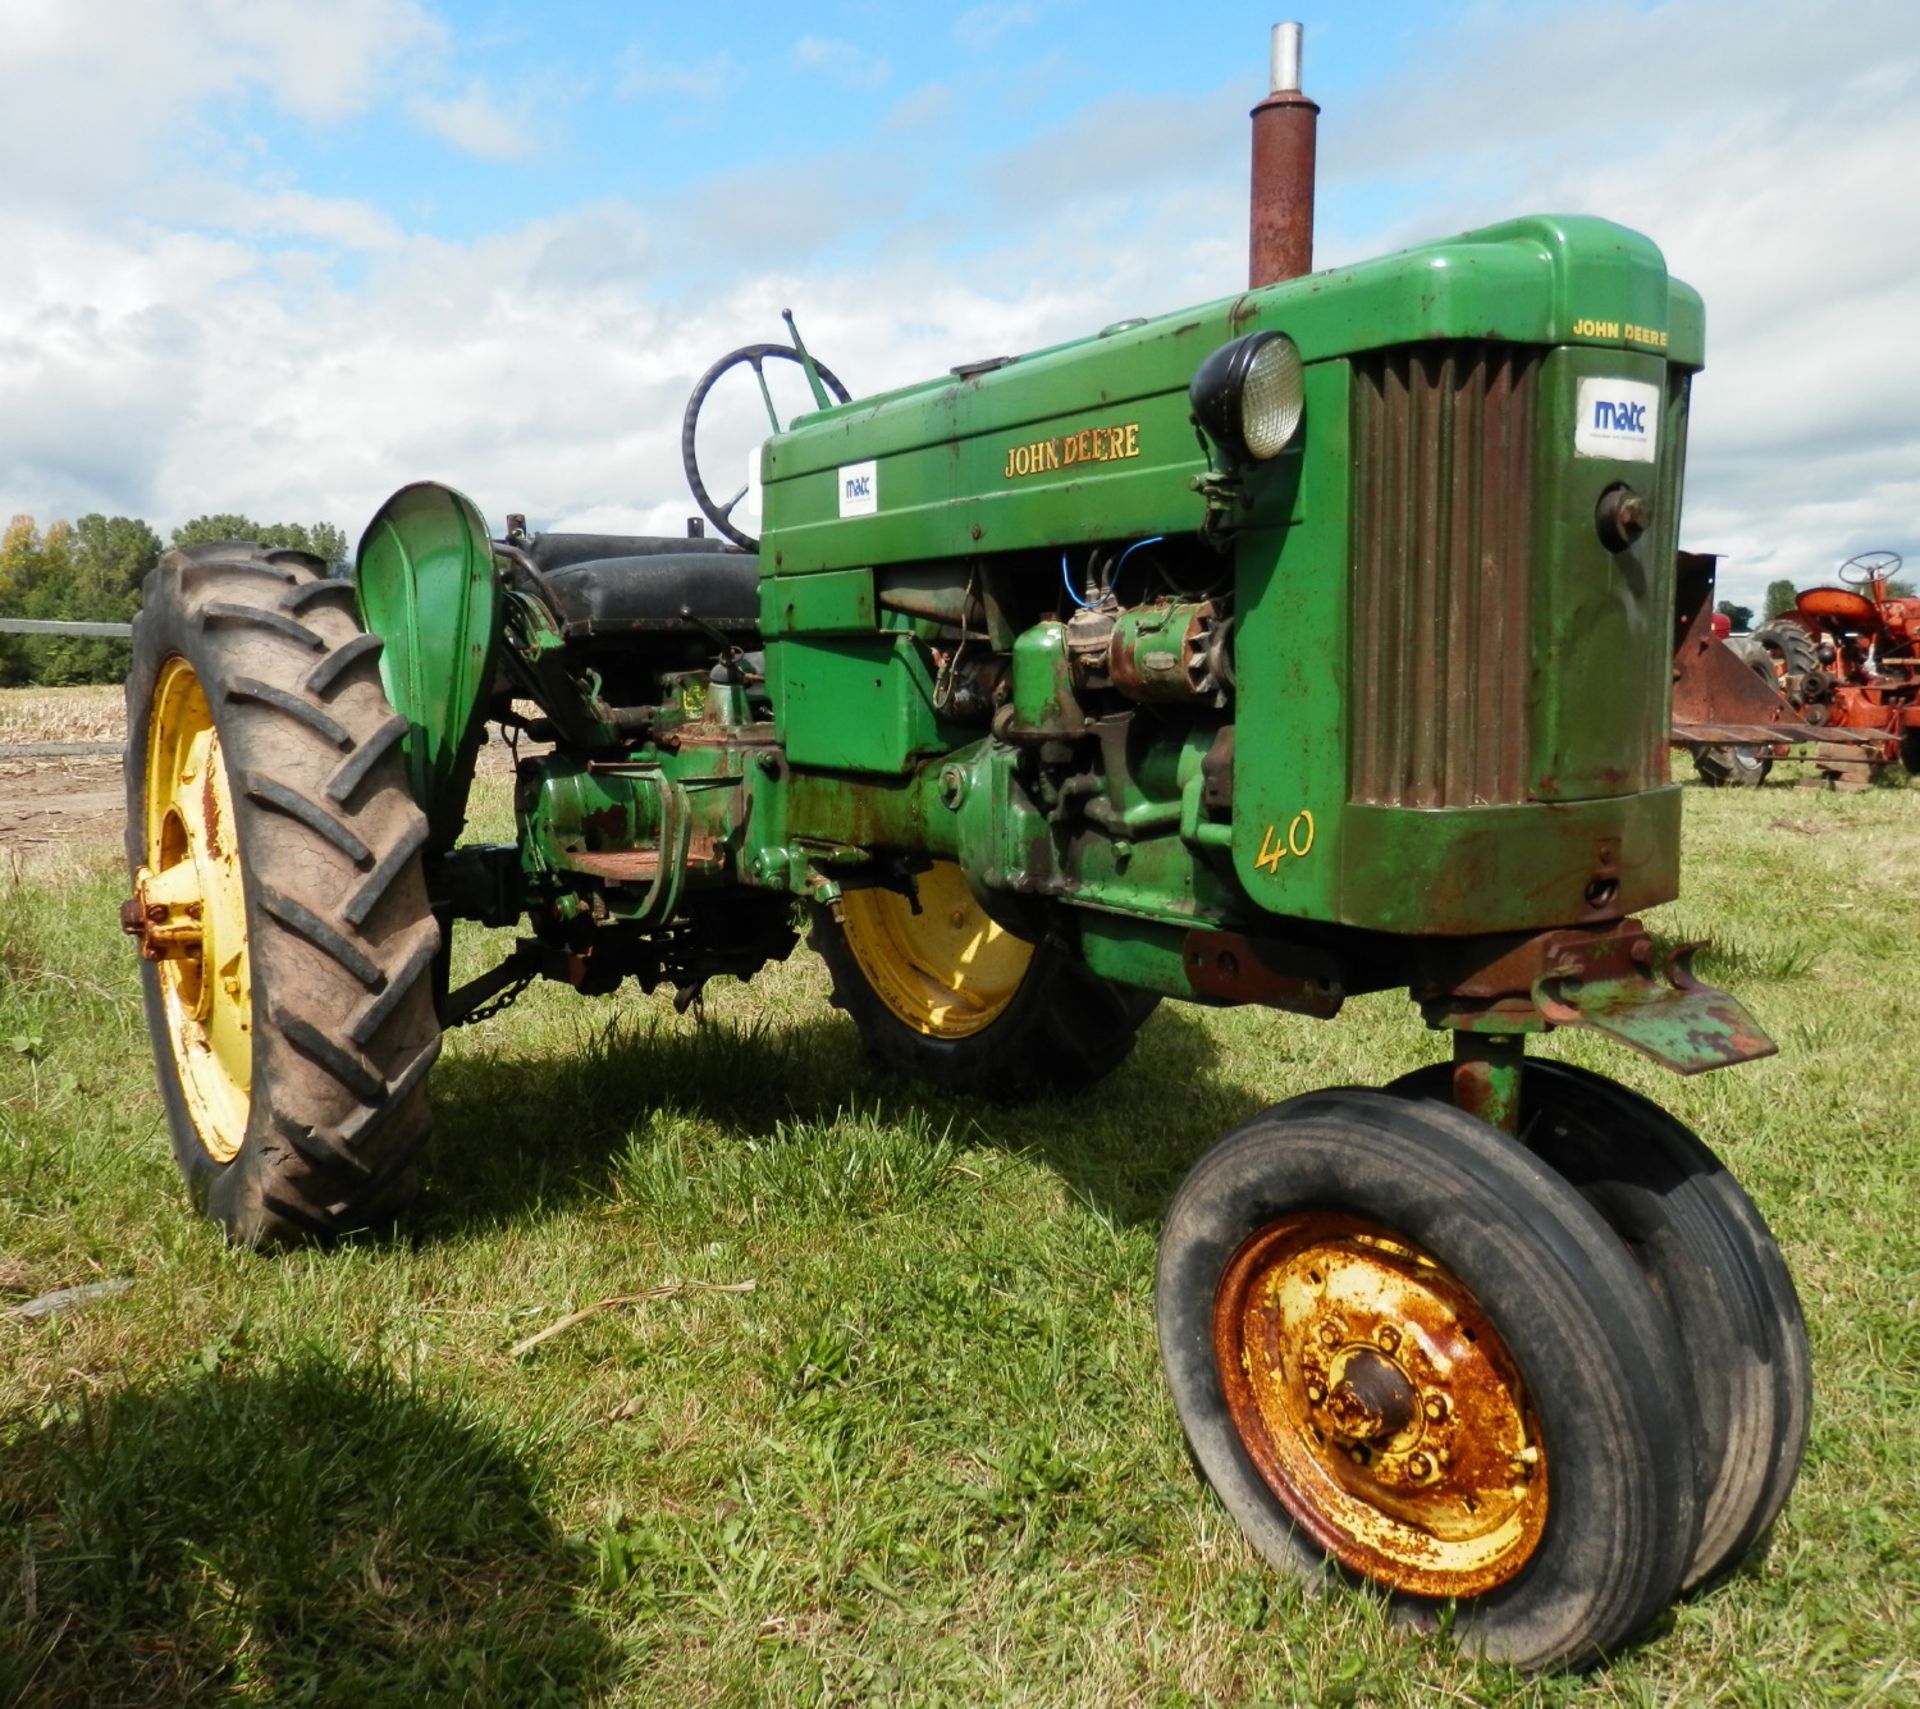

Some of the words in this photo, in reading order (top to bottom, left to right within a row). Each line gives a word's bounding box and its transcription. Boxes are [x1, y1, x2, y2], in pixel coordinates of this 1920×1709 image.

[1573, 319, 1619, 339] JOHN
[1625, 323, 1669, 347] DEERE
[1005, 437, 1059, 478] JOHN
[1063, 423, 1140, 465] DEERE
[1253, 809, 1315, 875] 40
